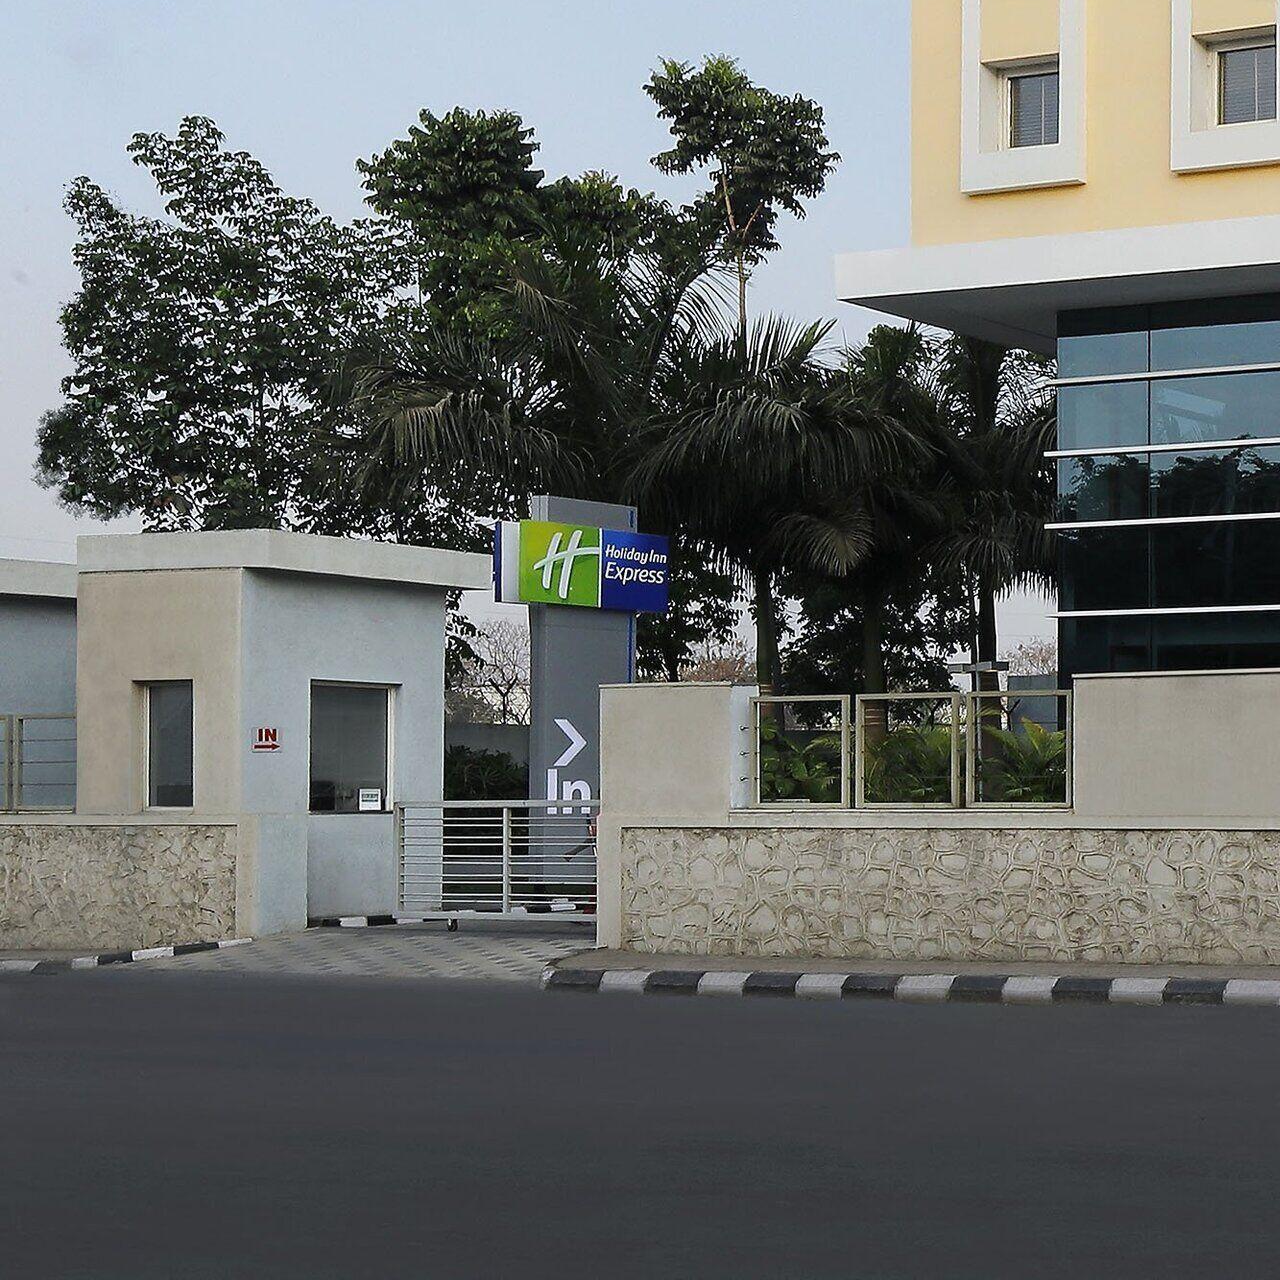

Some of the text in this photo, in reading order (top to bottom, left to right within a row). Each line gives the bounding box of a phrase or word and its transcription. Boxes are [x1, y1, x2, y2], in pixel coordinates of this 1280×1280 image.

[605, 544, 667, 565] Holiday Inn
[605, 561, 665, 586] Express
[257, 728, 277, 742] IN
[547, 770, 591, 815] In
